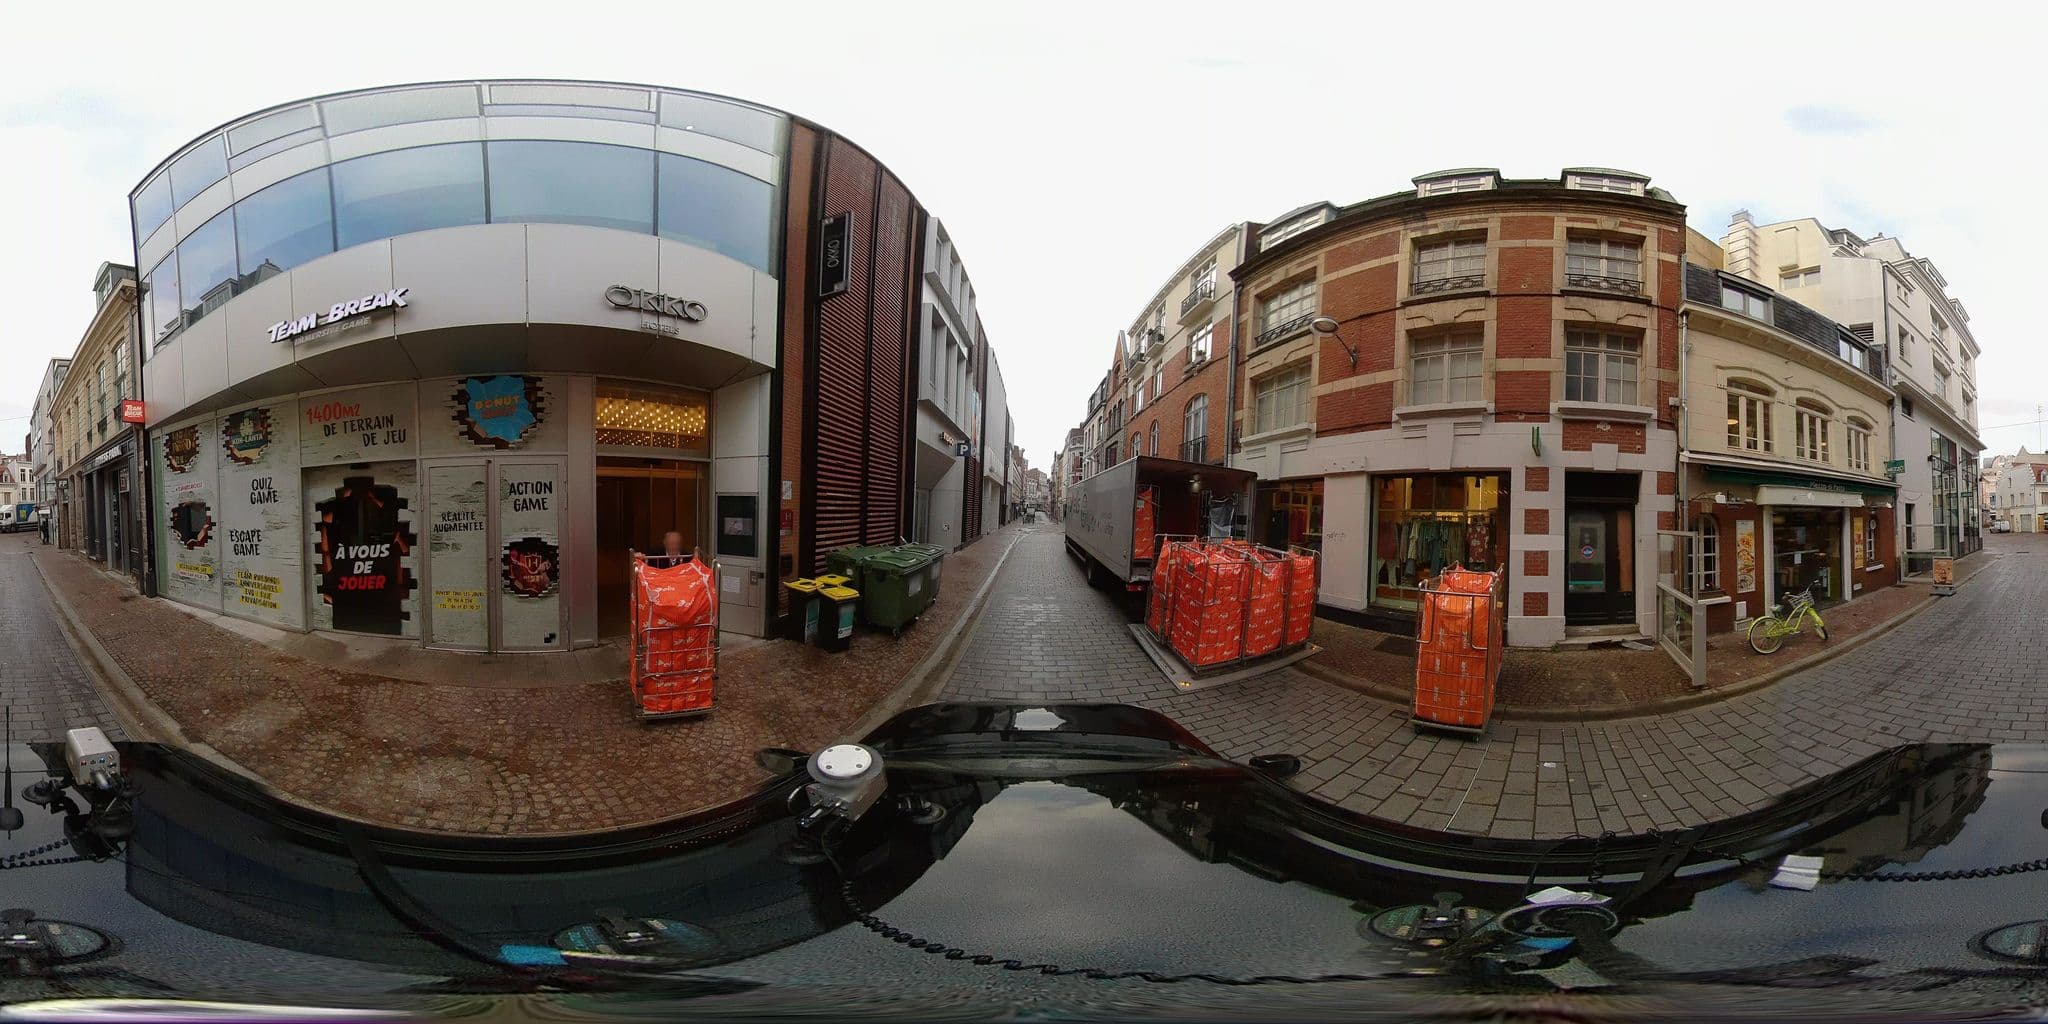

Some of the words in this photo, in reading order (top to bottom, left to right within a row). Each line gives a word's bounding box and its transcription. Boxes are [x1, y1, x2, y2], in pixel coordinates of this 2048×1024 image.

[605, 285, 708, 321] OKKO
[641, 321, 680, 335] HOTELS
[323, 423, 338, 437] DE
[342, 414, 394, 434] TERRAIN
[362, 432, 378, 447] DE
[383, 429, 406, 445] JEU
[960, 444, 969, 454] P
[252, 477, 274, 491] QUIZ
[509, 481, 553, 496] ACTION
[250, 490, 279, 504] GAME
[513, 498, 549, 512] GAME
[229, 529, 262, 543] ESCAPE
[233, 543, 261, 556] GAME
[335, 543, 346, 559] À
[349, 544, 390, 558] VOUS
[353, 561, 374, 574] DE
[338, 576, 386, 590] JOUER
